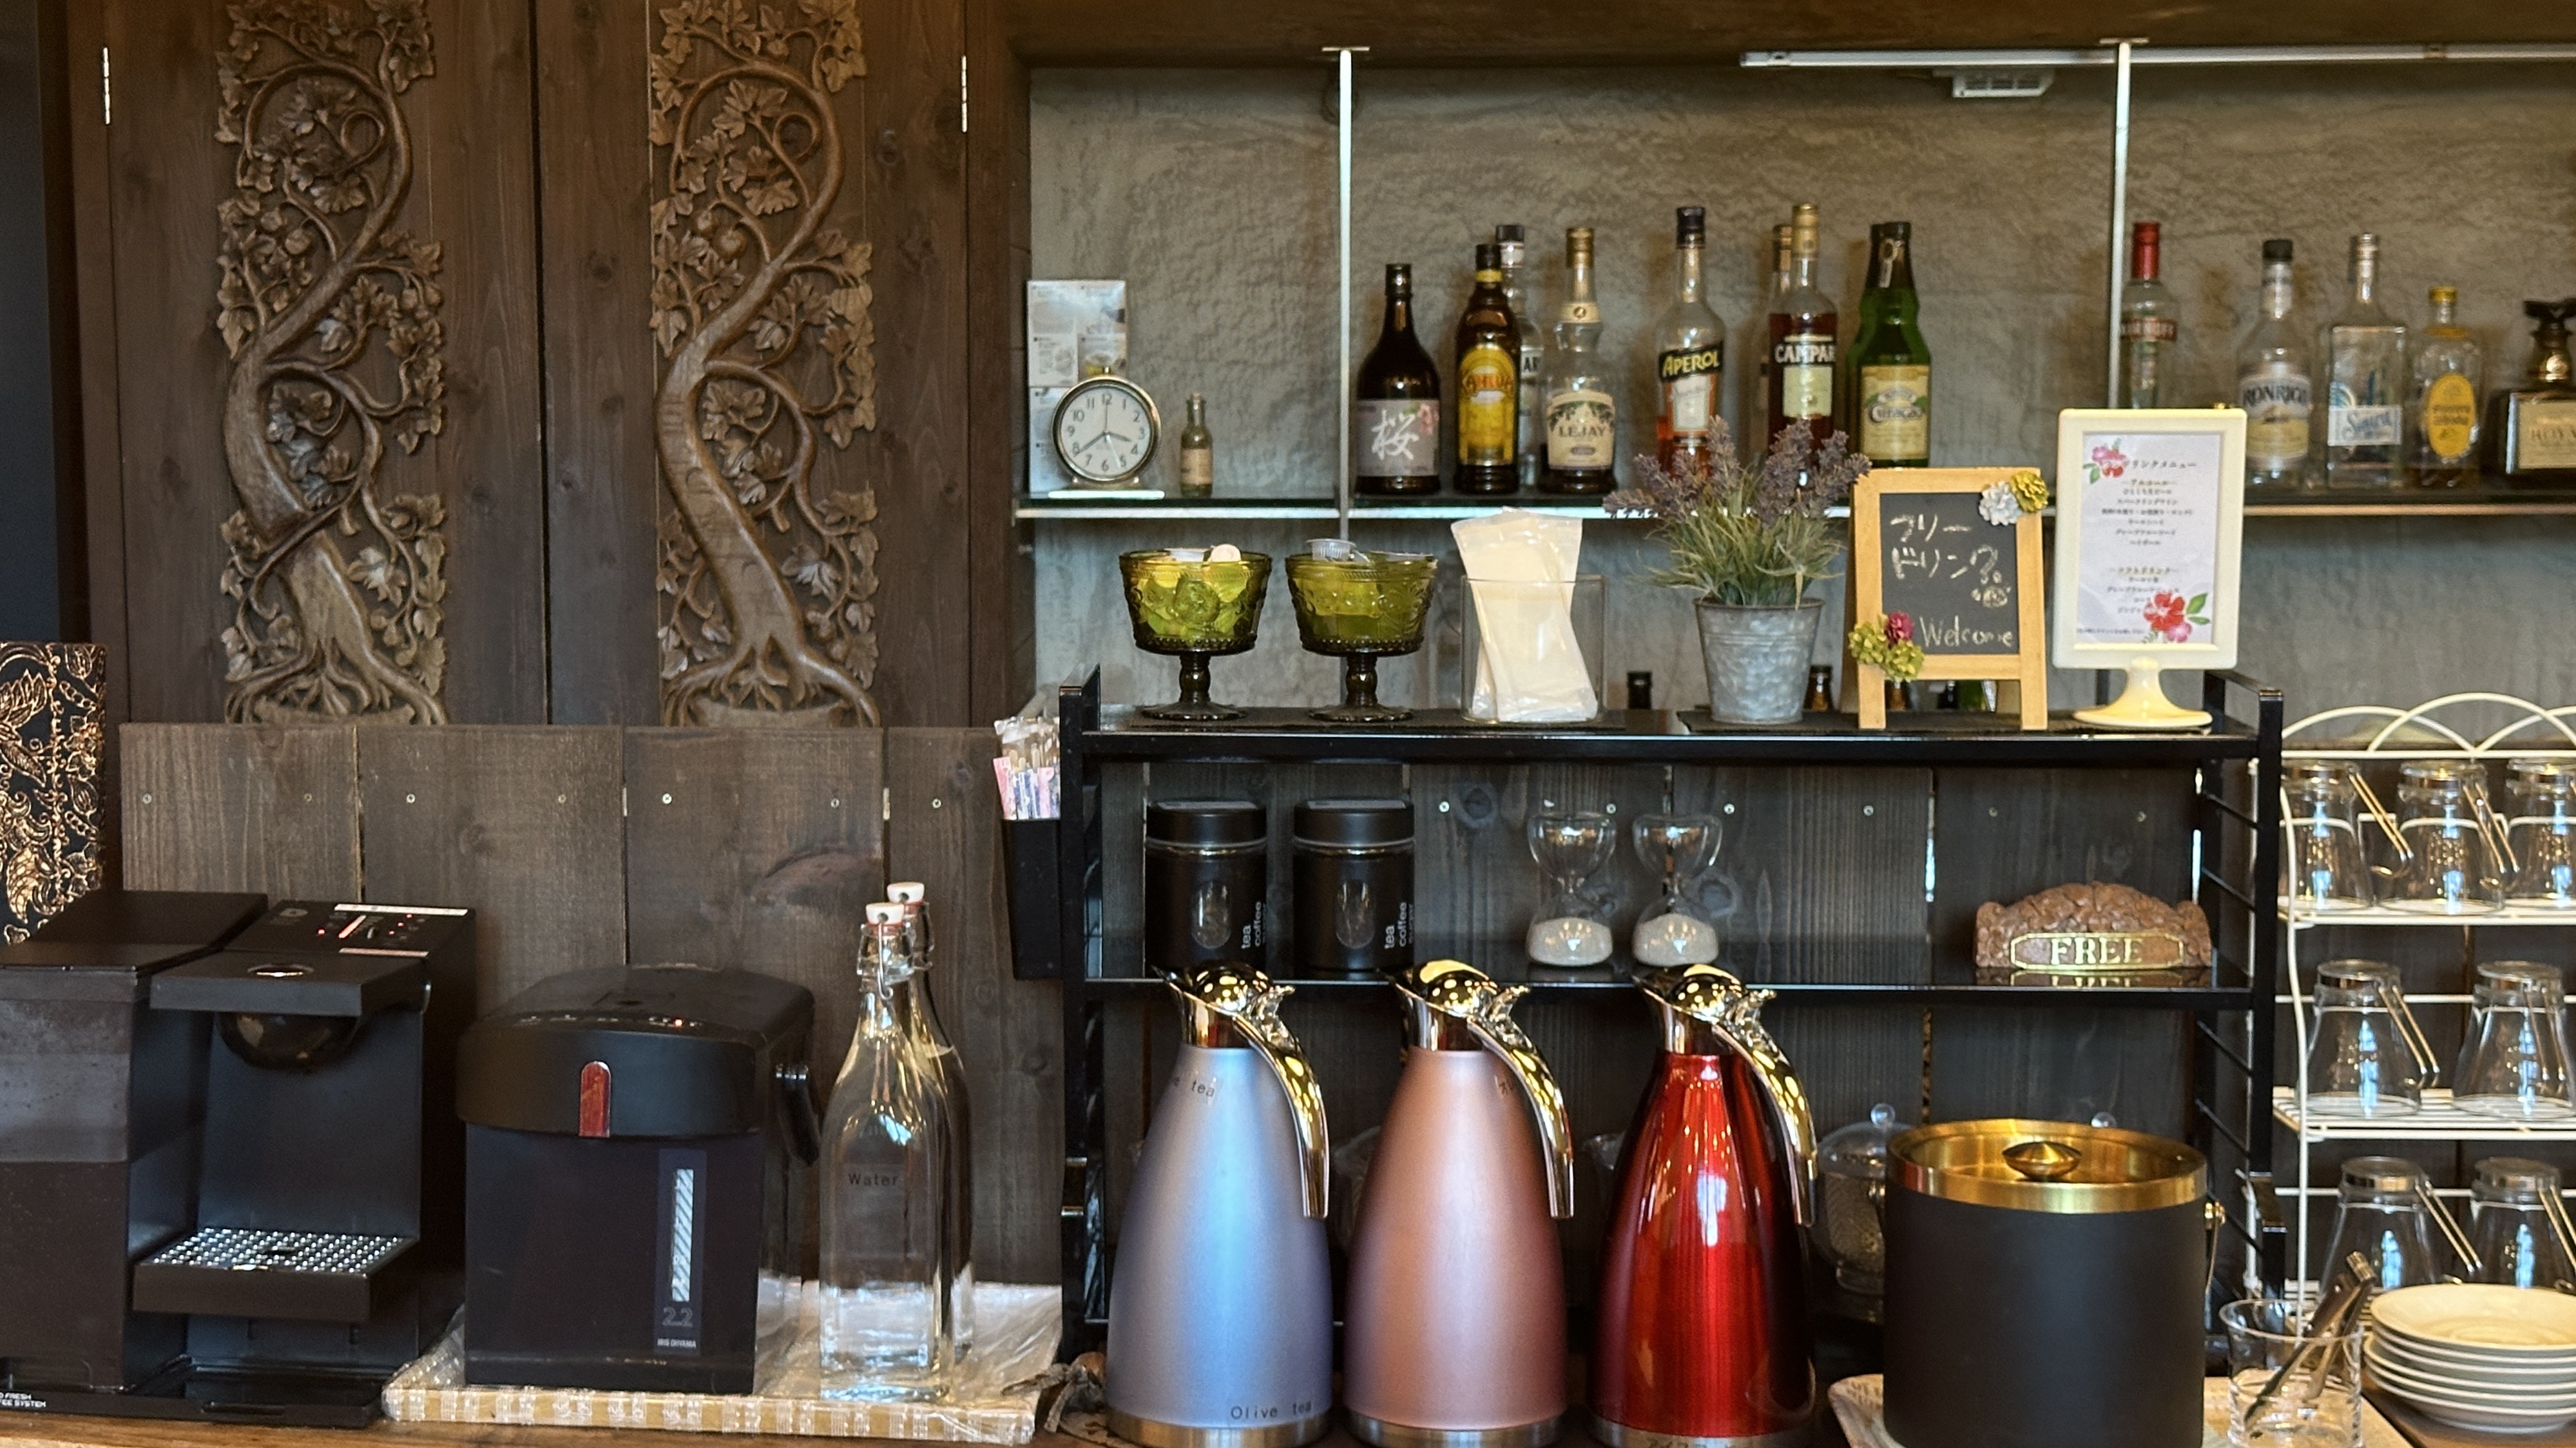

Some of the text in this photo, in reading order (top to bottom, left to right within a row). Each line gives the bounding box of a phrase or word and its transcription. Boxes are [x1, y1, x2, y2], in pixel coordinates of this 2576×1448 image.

[1662, 350, 1720, 377] APEROL
[1087, 397, 1095, 410] 11
[1101, 393, 1113, 405] 12
[1122, 399, 1126, 410] 1
[1073, 410, 1085, 423] 10
[1133, 410, 1140, 423] 2
[1067, 426, 1075, 437] 9
[1138, 426, 1146, 440] 3
[1370, 408, 1420, 461] 桜
[1559, 425, 1606, 438] LEJAY
[1072, 442, 1080, 456] 8
[1131, 444, 1139, 455] 4
[1085, 454, 1093, 466] 7
[1101, 459, 1110, 472] 6
[1120, 455, 1127, 468] 5
[1890, 513, 1972, 542] フリー
[1891, 544, 1999, 585] ドリンク
[1919, 615, 2015, 648] Welcome
[1253, 901, 1262, 947] coffee
[1397, 902, 1407, 948] coffee
[1241, 924, 1251, 949] tea
[1384, 925, 1395, 949] tea
[2050, 937, 2142, 966] FREE
[848, 1172, 900, 1186] Water
[1231, 1400, 1312, 1420] Olive tea
